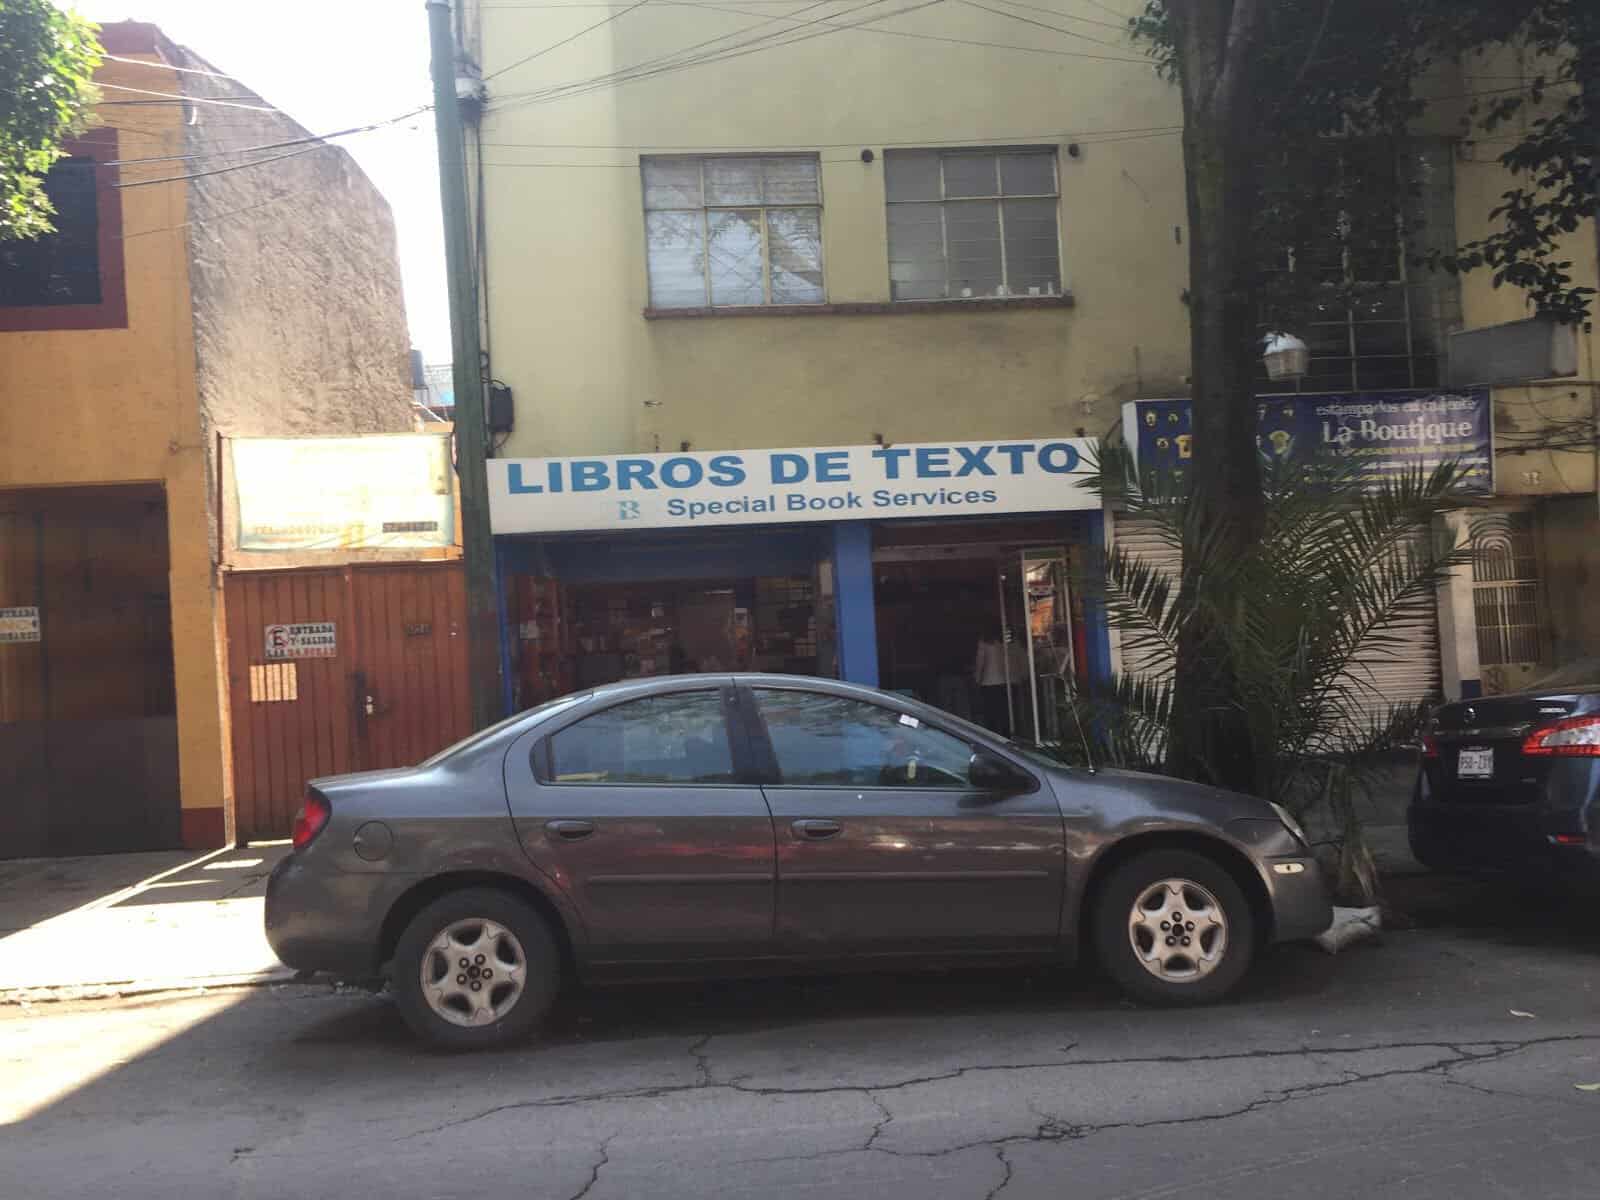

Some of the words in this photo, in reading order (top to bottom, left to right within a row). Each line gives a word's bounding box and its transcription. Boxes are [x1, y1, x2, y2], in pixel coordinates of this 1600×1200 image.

[1322, 421, 1355, 445] La
[1359, 415, 1473, 446] Boutique
[507, 455, 747, 496] LIBROS
[769, 449, 851, 485] DE
[872, 443, 1080, 481] TEXTO
[666, 494, 776, 520] Special
[787, 491, 862, 511] Book
[873, 487, 998, 507] Services
[288, 625, 335, 634] ENTRADA
